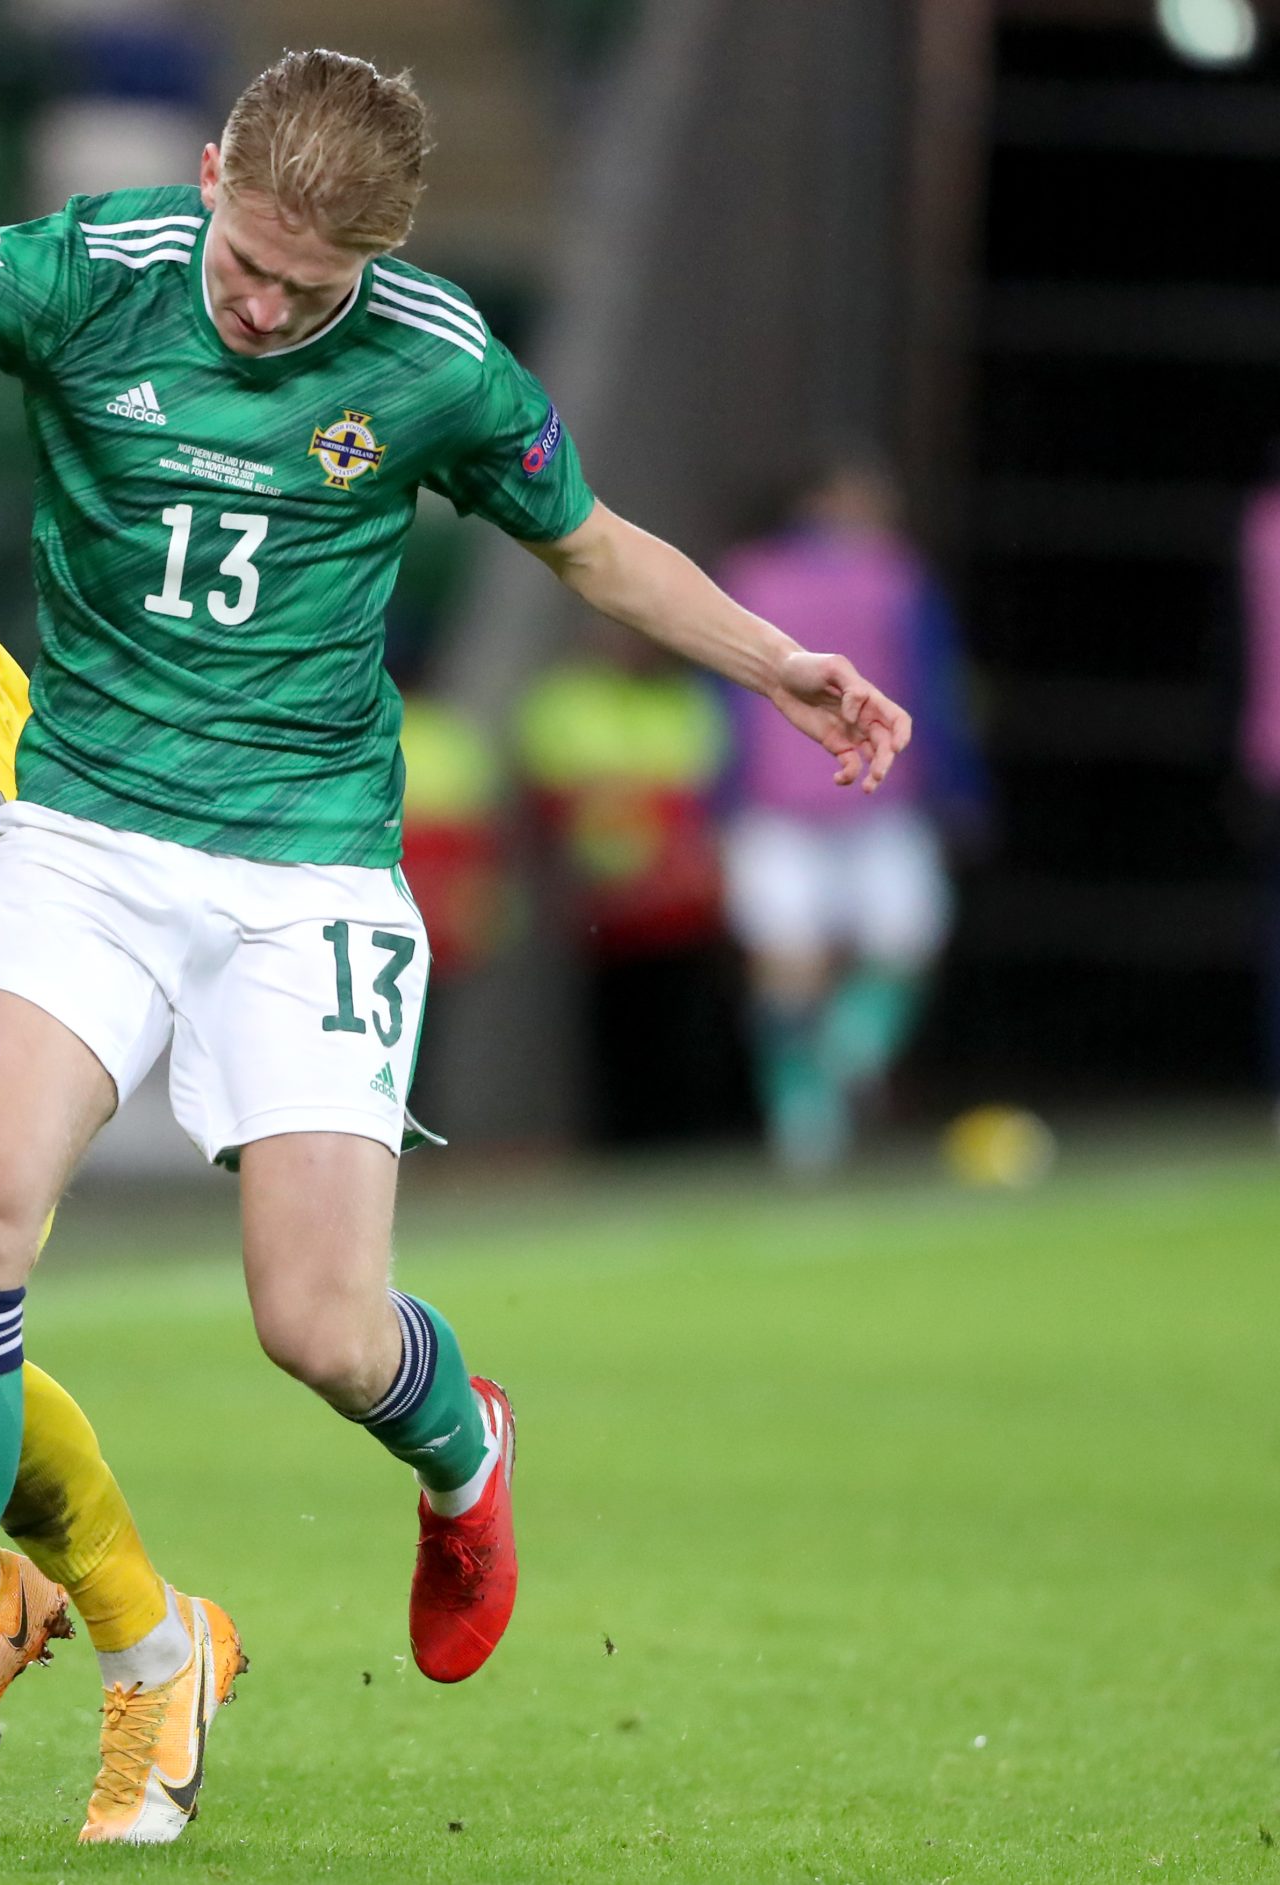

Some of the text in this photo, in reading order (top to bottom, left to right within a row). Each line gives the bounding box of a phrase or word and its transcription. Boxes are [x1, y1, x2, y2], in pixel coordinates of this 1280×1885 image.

[106, 401, 167, 426] adidas
[177, 443, 274, 476] NORTHERN IRELAND V ROMANIA
[320, 440, 374, 459] NORTHERN IRELAND
[159, 458, 190, 474] NATIONAL
[191, 466, 224, 482] FOOTBALL
[254, 482, 282, 497] BELFAST
[205, 460, 240, 476] NOVEMBER
[144, 504, 269, 626] 13
[321, 920, 416, 1048] 13
